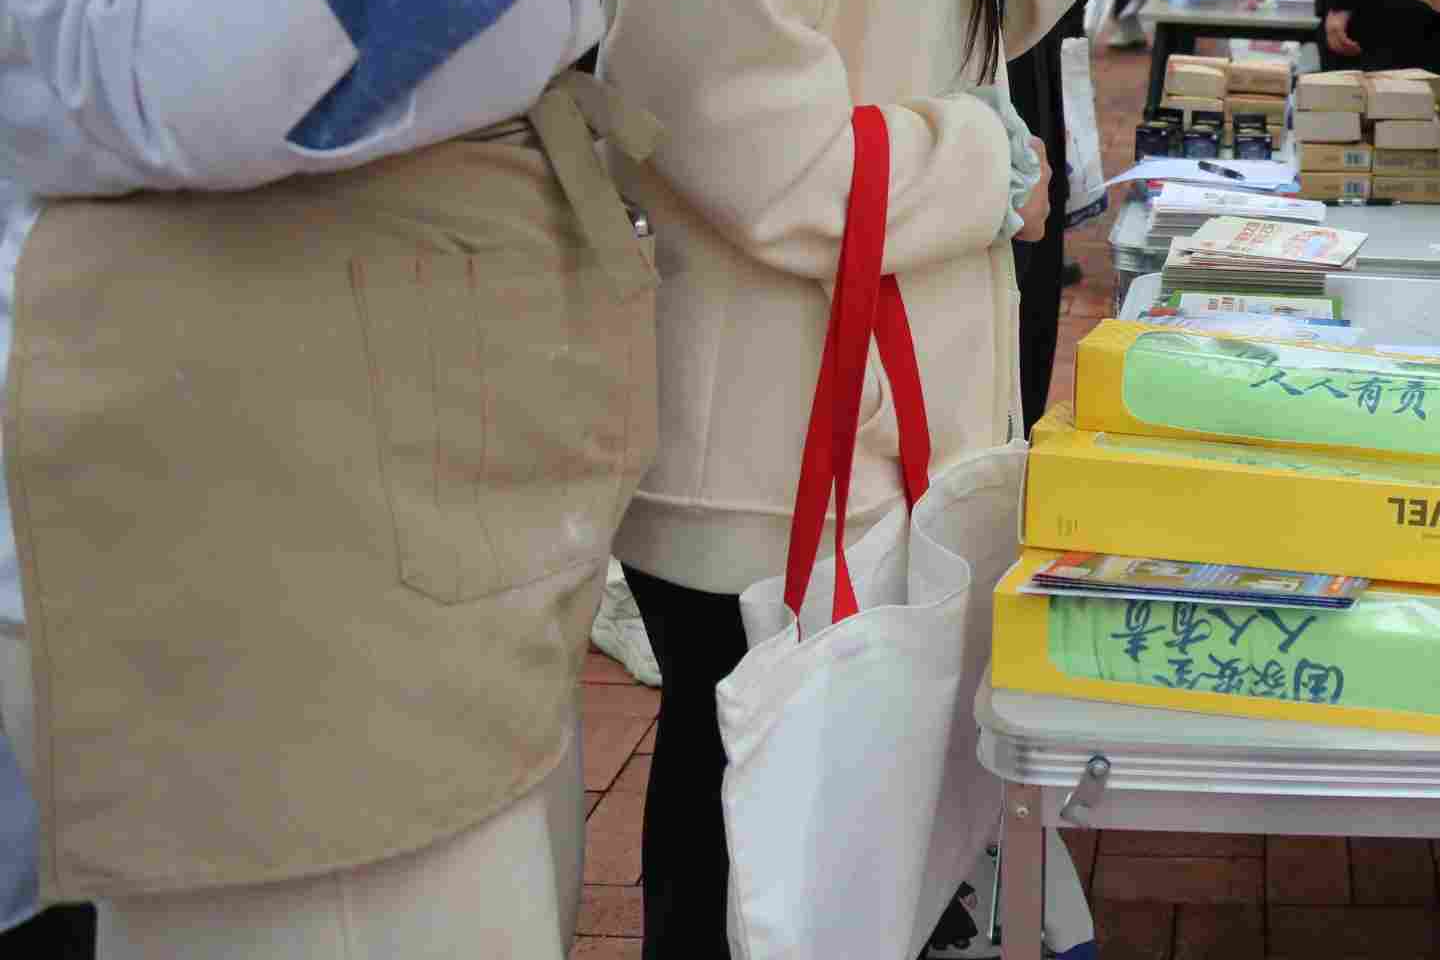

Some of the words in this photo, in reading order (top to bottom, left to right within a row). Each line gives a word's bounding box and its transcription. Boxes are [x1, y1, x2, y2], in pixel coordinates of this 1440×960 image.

[1249, 375, 1440, 421] 人人有责
[1110, 597, 1318, 663] 人人有责
[1151, 652, 1345, 705] 国家安全
